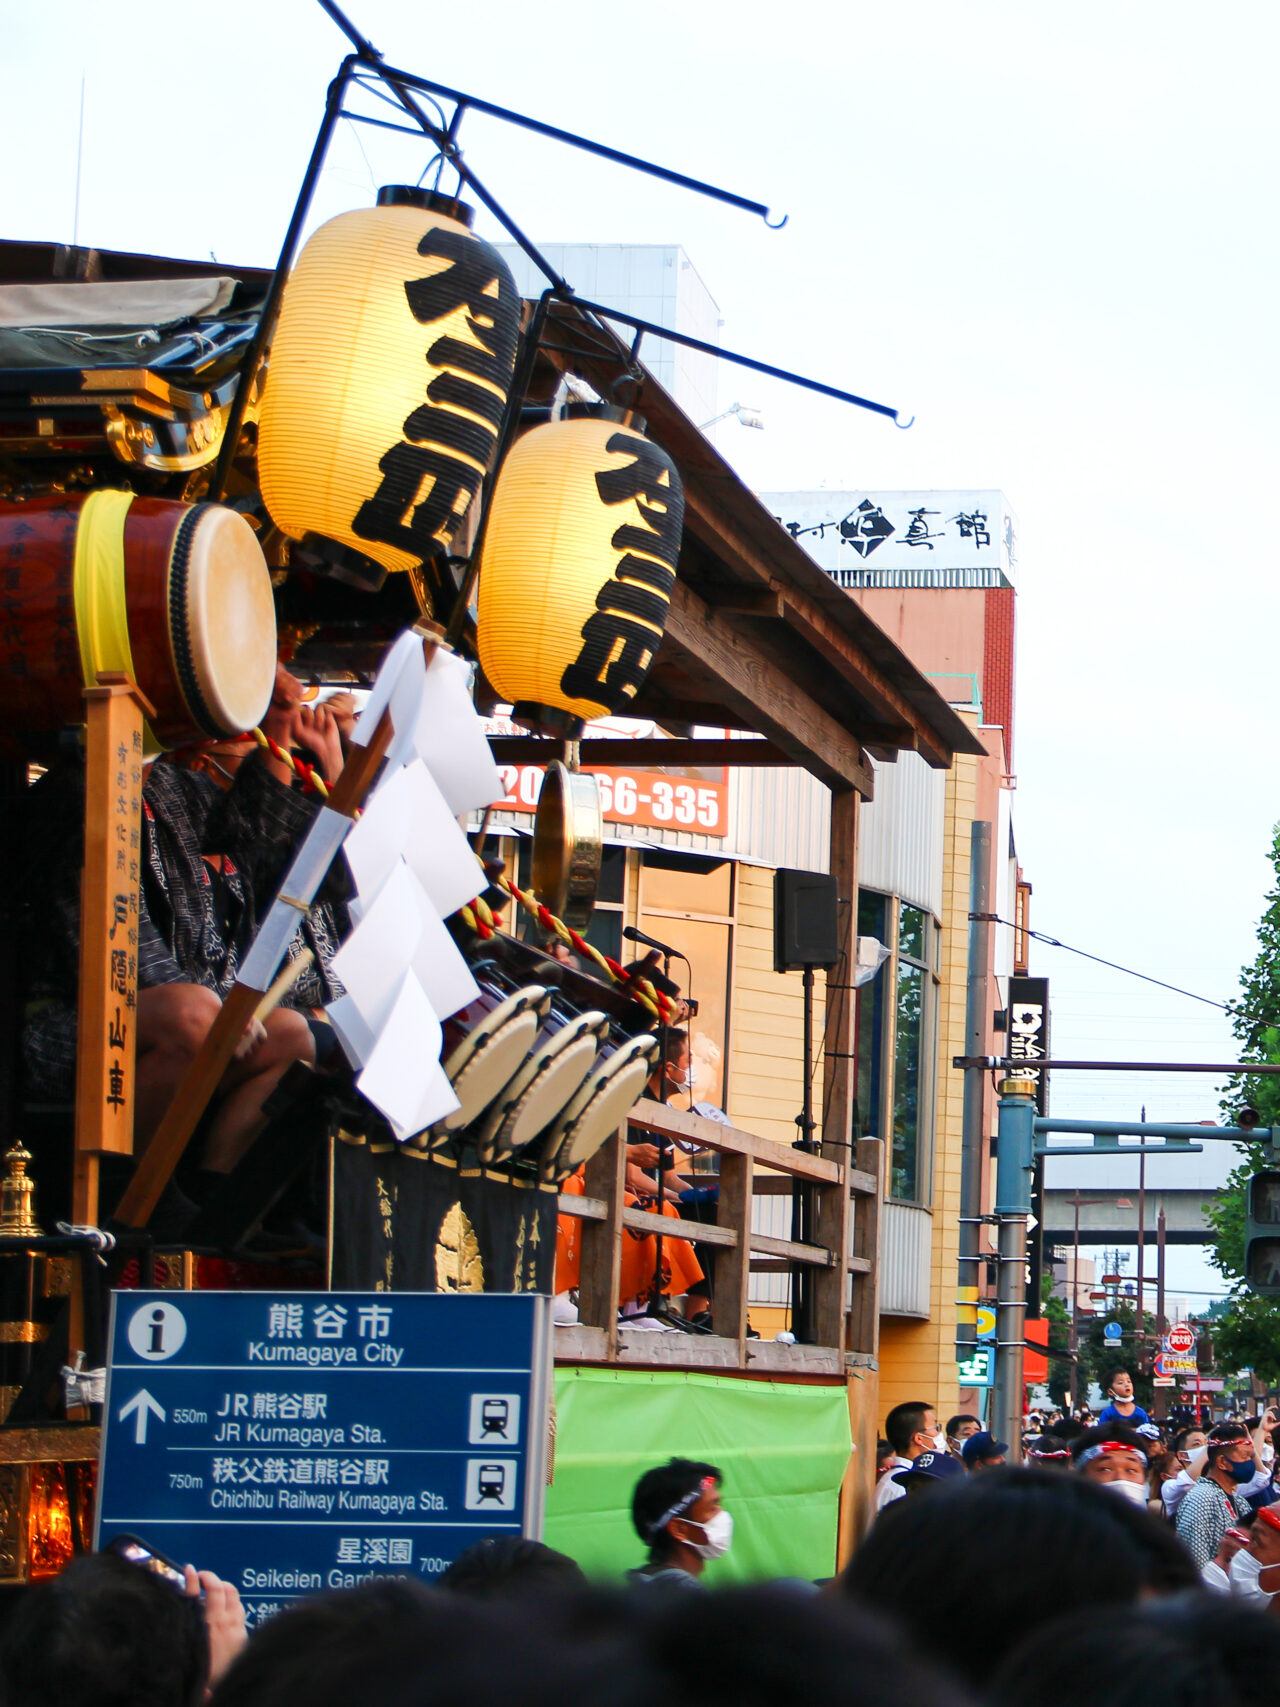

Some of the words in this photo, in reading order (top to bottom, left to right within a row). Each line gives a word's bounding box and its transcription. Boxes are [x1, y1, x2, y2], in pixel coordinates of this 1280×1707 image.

[267, 1303, 393, 1339] 熊谷市
[248, 1342, 357, 1365] Kumagaya
[363, 1344, 404, 1366] City
[173, 1408, 208, 1425] 550m
[214, 1423, 240, 1442] JR
[246, 1424, 345, 1447] Kumagaya
[350, 1424, 387, 1444] Sta.
[169, 1472, 203, 1491] 750m
[212, 1457, 390, 1486] 秩父鉄道熊谷駅
[210, 1488, 273, 1509] Chichibu
[278, 1490, 335, 1514] Railway
[338, 1491, 417, 1515] Kumagaya
[419, 1493, 449, 1512] Sta.
[241, 1568, 323, 1589] Seikeien
